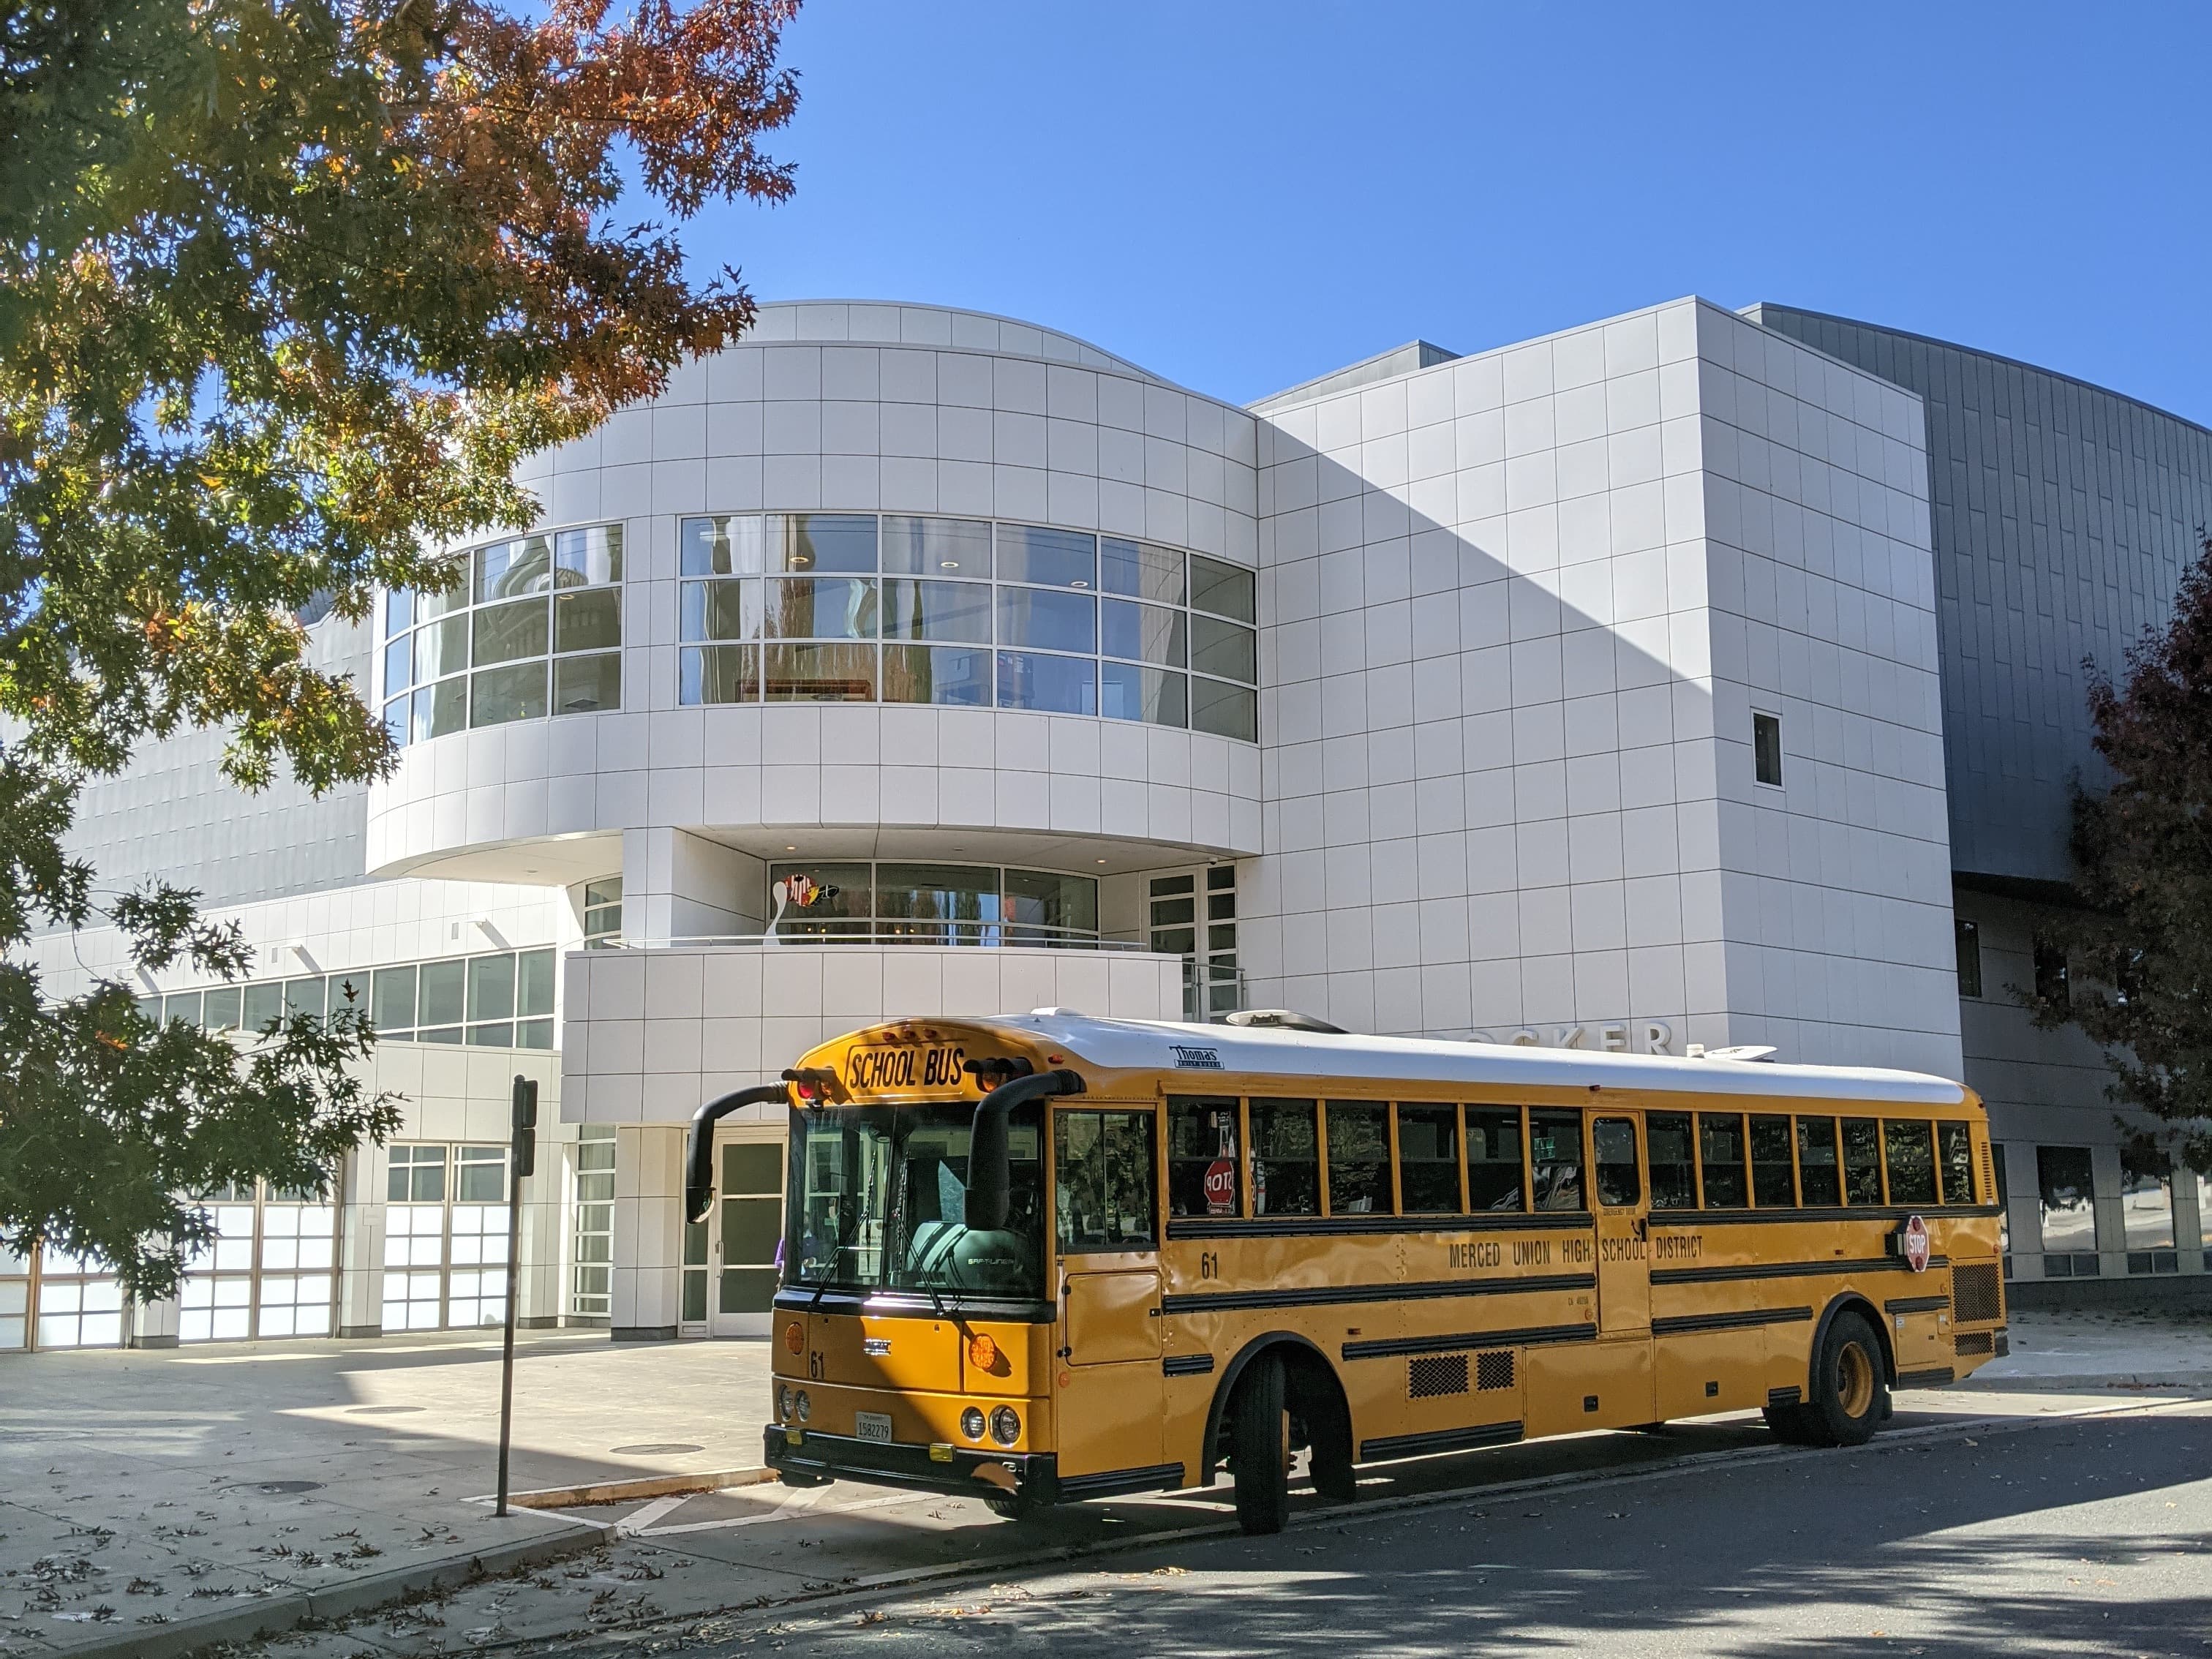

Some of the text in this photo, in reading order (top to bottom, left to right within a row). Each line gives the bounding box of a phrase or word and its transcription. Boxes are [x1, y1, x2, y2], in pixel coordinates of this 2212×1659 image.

[1169, 1045, 1218, 1061] Thomas
[849, 1047, 964, 1089] SCHOOL BUS
[1449, 1235, 1703, 1268] MERCED UNION HIGH SCHOOL DISTRICT
[1909, 1234, 1926, 1254] STOP
[1201, 1252, 1218, 1280] 61
[810, 1350, 824, 1380] 61
[858, 1421, 889, 1439] 1582279
